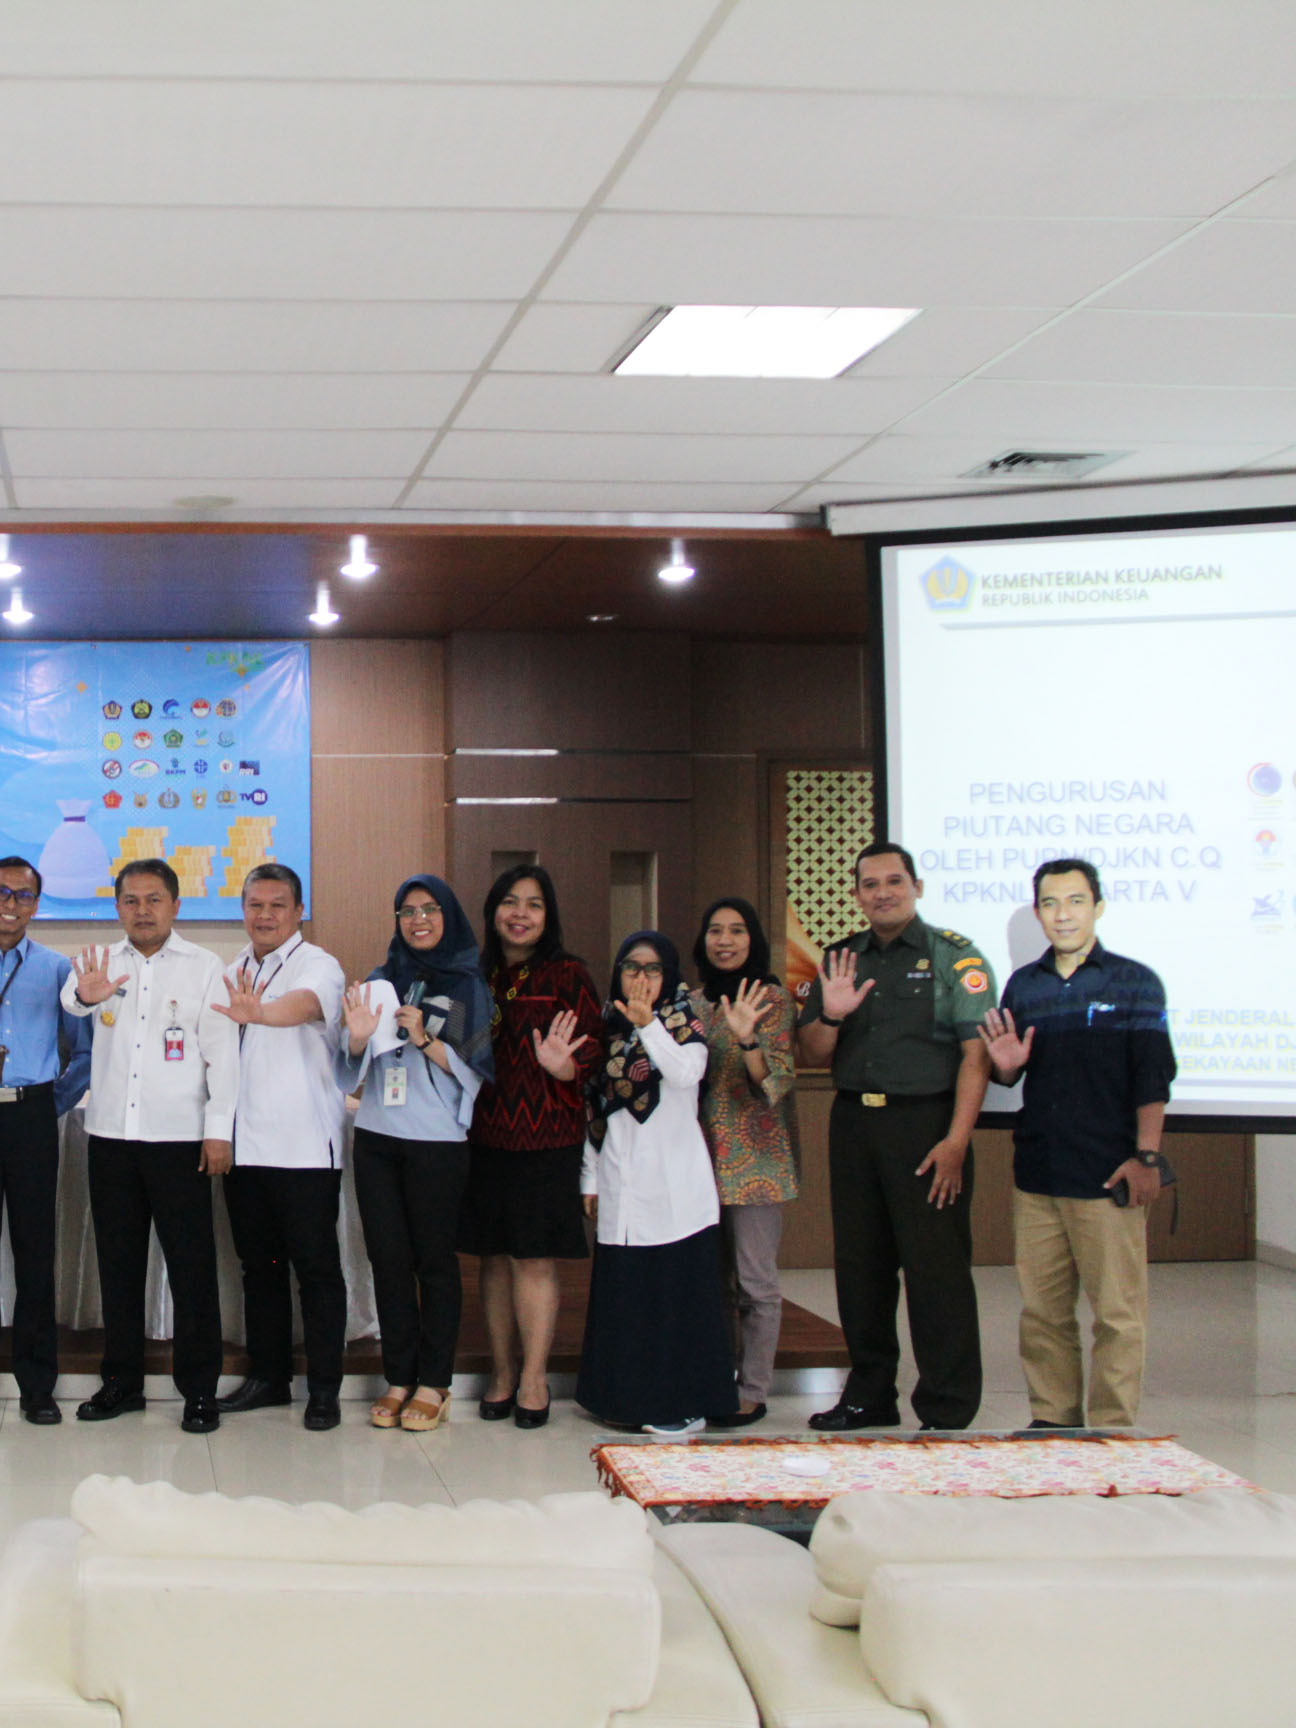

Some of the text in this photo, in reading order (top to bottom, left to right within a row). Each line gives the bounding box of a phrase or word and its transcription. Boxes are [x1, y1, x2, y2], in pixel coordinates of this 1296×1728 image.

[981, 564, 1224, 590] KEMENTERIAN KEUANGAN
[981, 587, 1150, 608] REPUBLIK INDONESIA
[970, 779, 1167, 805] PENGURUSAN
[944, 812, 1196, 838] PIUTANG NEGARA
[920, 849, 993, 872] OLEH
[944, 881, 1034, 904] KPKNL
[1177, 879, 1198, 902] V
[1175, 1031, 1270, 1049] WILAYAH
